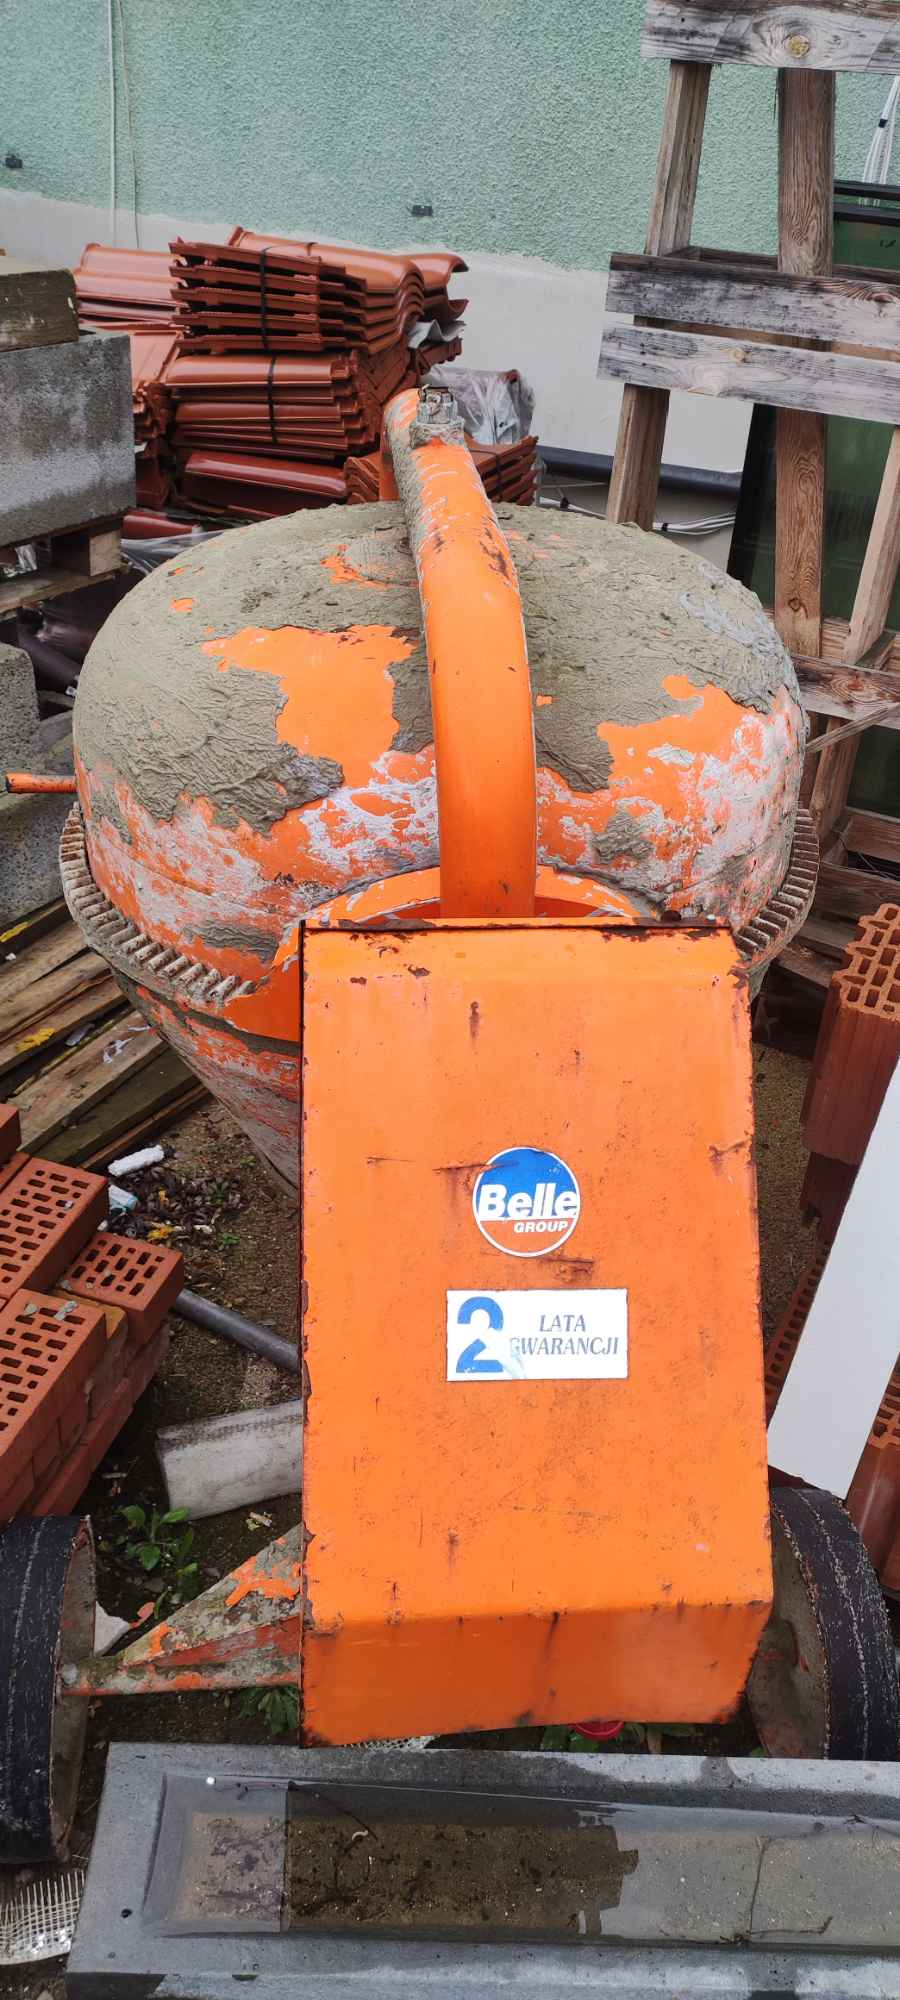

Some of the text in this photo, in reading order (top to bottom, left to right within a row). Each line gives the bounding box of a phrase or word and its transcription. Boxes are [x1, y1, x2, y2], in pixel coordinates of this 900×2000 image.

[477, 1183, 578, 1219] Belle
[514, 1221, 569, 1233] GROUP
[456, 1296, 504, 1373] 2
[539, 1314, 586, 1332] LATA
